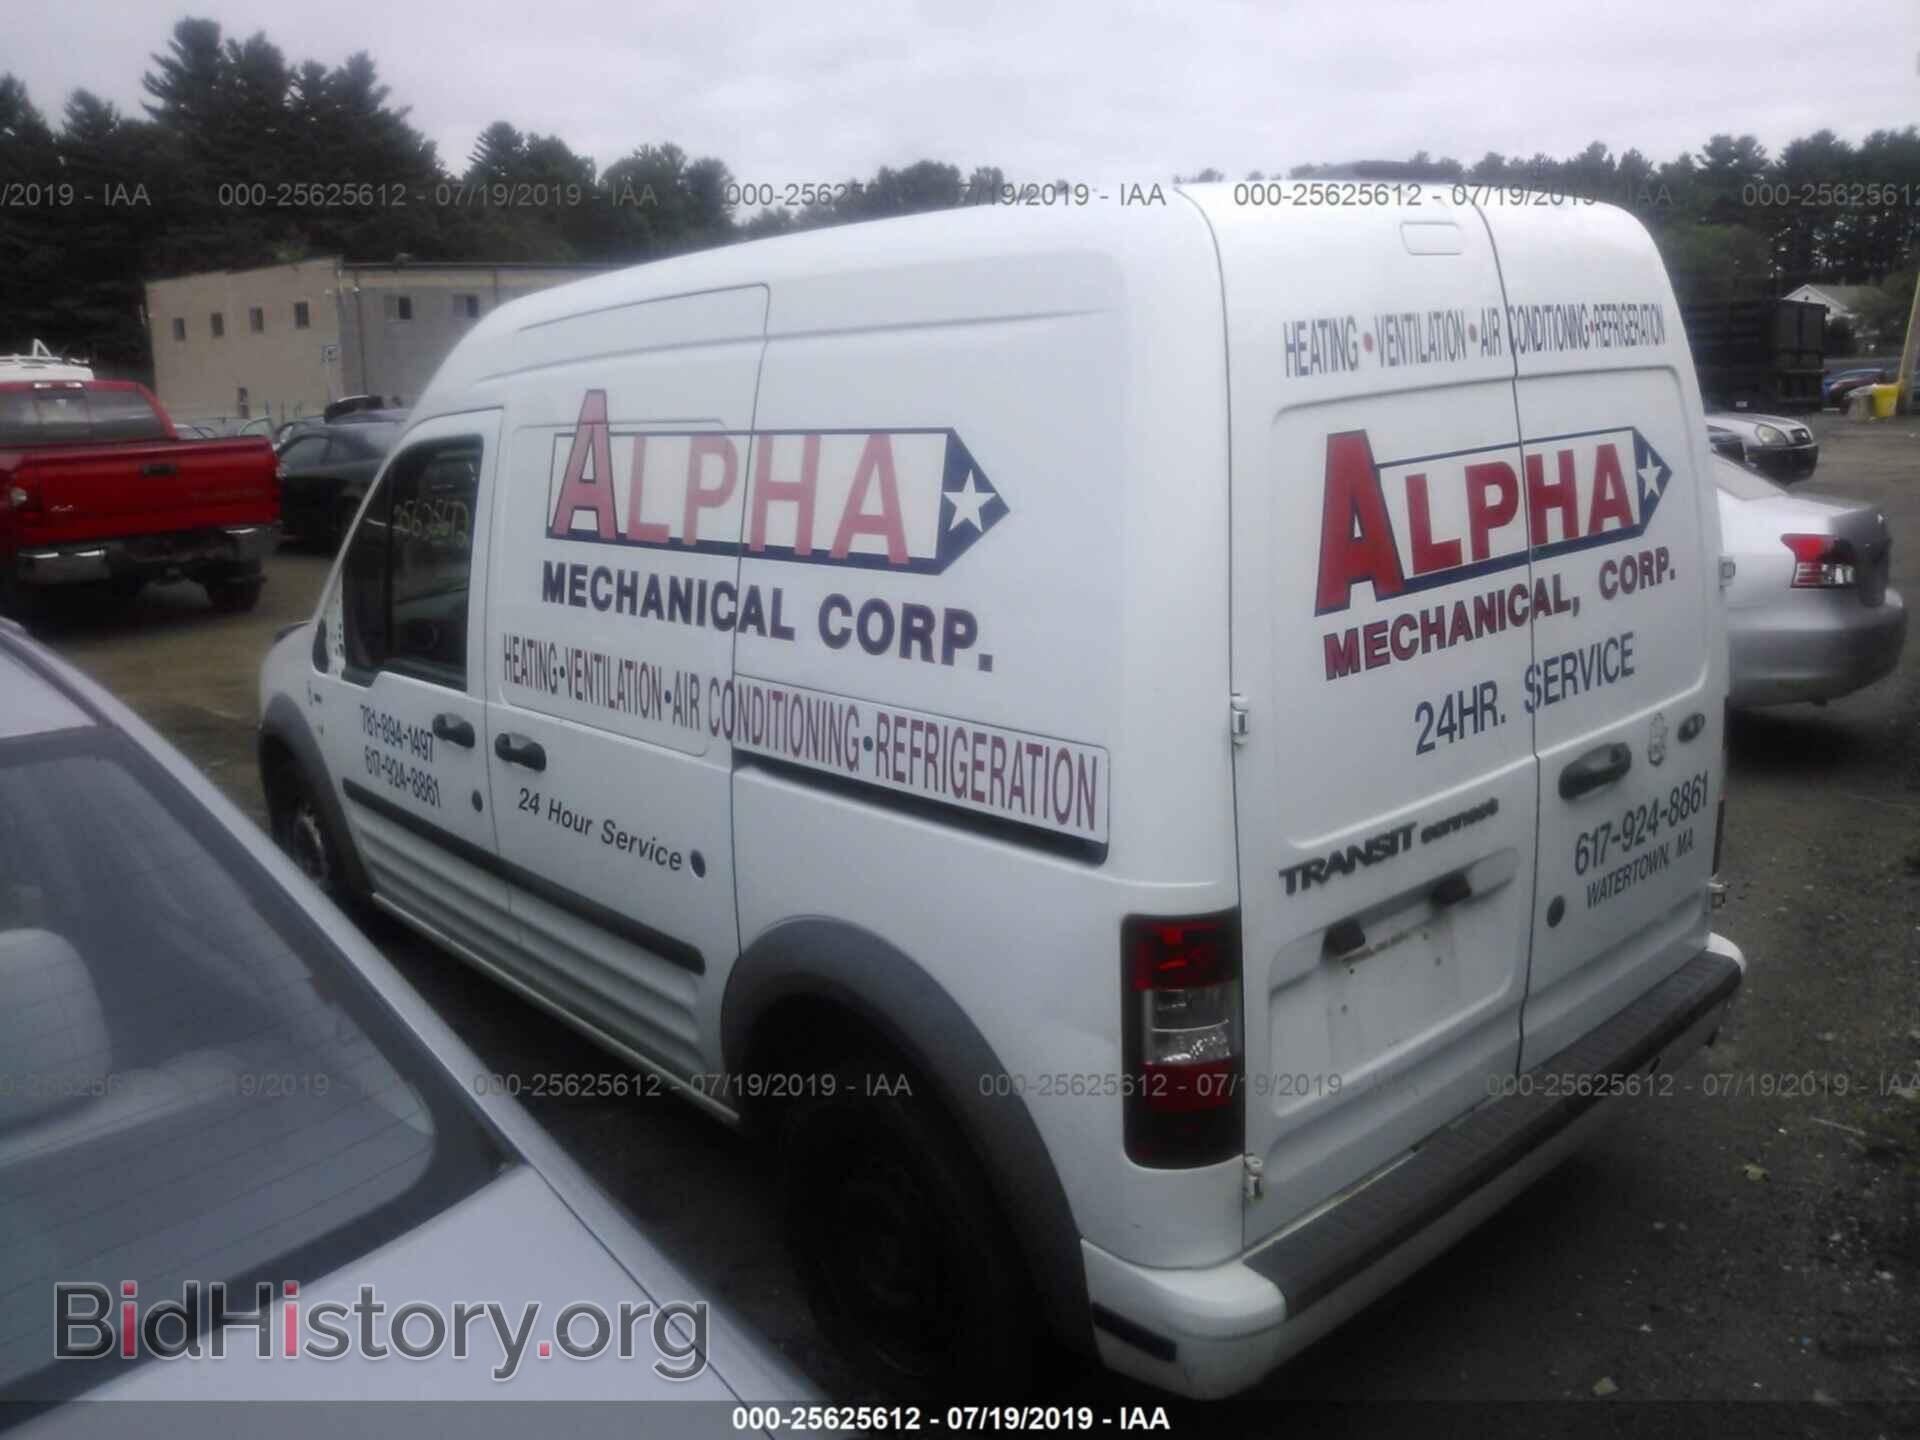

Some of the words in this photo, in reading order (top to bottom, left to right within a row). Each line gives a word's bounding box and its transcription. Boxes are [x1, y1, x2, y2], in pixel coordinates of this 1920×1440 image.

[1283, 320, 1359, 377] HEATING
[1374, 310, 1467, 367] VENTILATION
[1480, 306, 1501, 358] AIR
[1509, 303, 1590, 355] CONDITIONING
[1594, 303, 1665, 347] REFRIGERATION
[551, 388, 909, 564] ALPHA
[1314, 429, 1637, 617] ALPHA
[541, 559, 796, 641] MECHANICAL
[817, 592, 994, 673] CORP.
[1323, 573, 1581, 681] MECHANICAL,
[1599, 547, 1676, 600] CORP.
[360, 703, 434, 763] 781-894-1497
[503, 633, 559, 690] HEATING
[565, 648, 663, 721] VENTILATION
[672, 669, 701, 731] AIR
[708, 678, 861, 775] CONDITIONING
[875, 712, 1097, 831] REFRIGERATION
[1414, 679, 1507, 755] 24HR.
[1524, 631, 1635, 714] SERVICE
[364, 744, 442, 808] 617-924-8861
[518, 788, 541, 816] 24
[548, 798, 594, 838] Hour
[601, 820, 683, 871] Service
[1574, 769, 1709, 876] 617-924-8861
[1278, 822, 1418, 895] TRANSIT
[1675, 827, 1694, 858] MA
